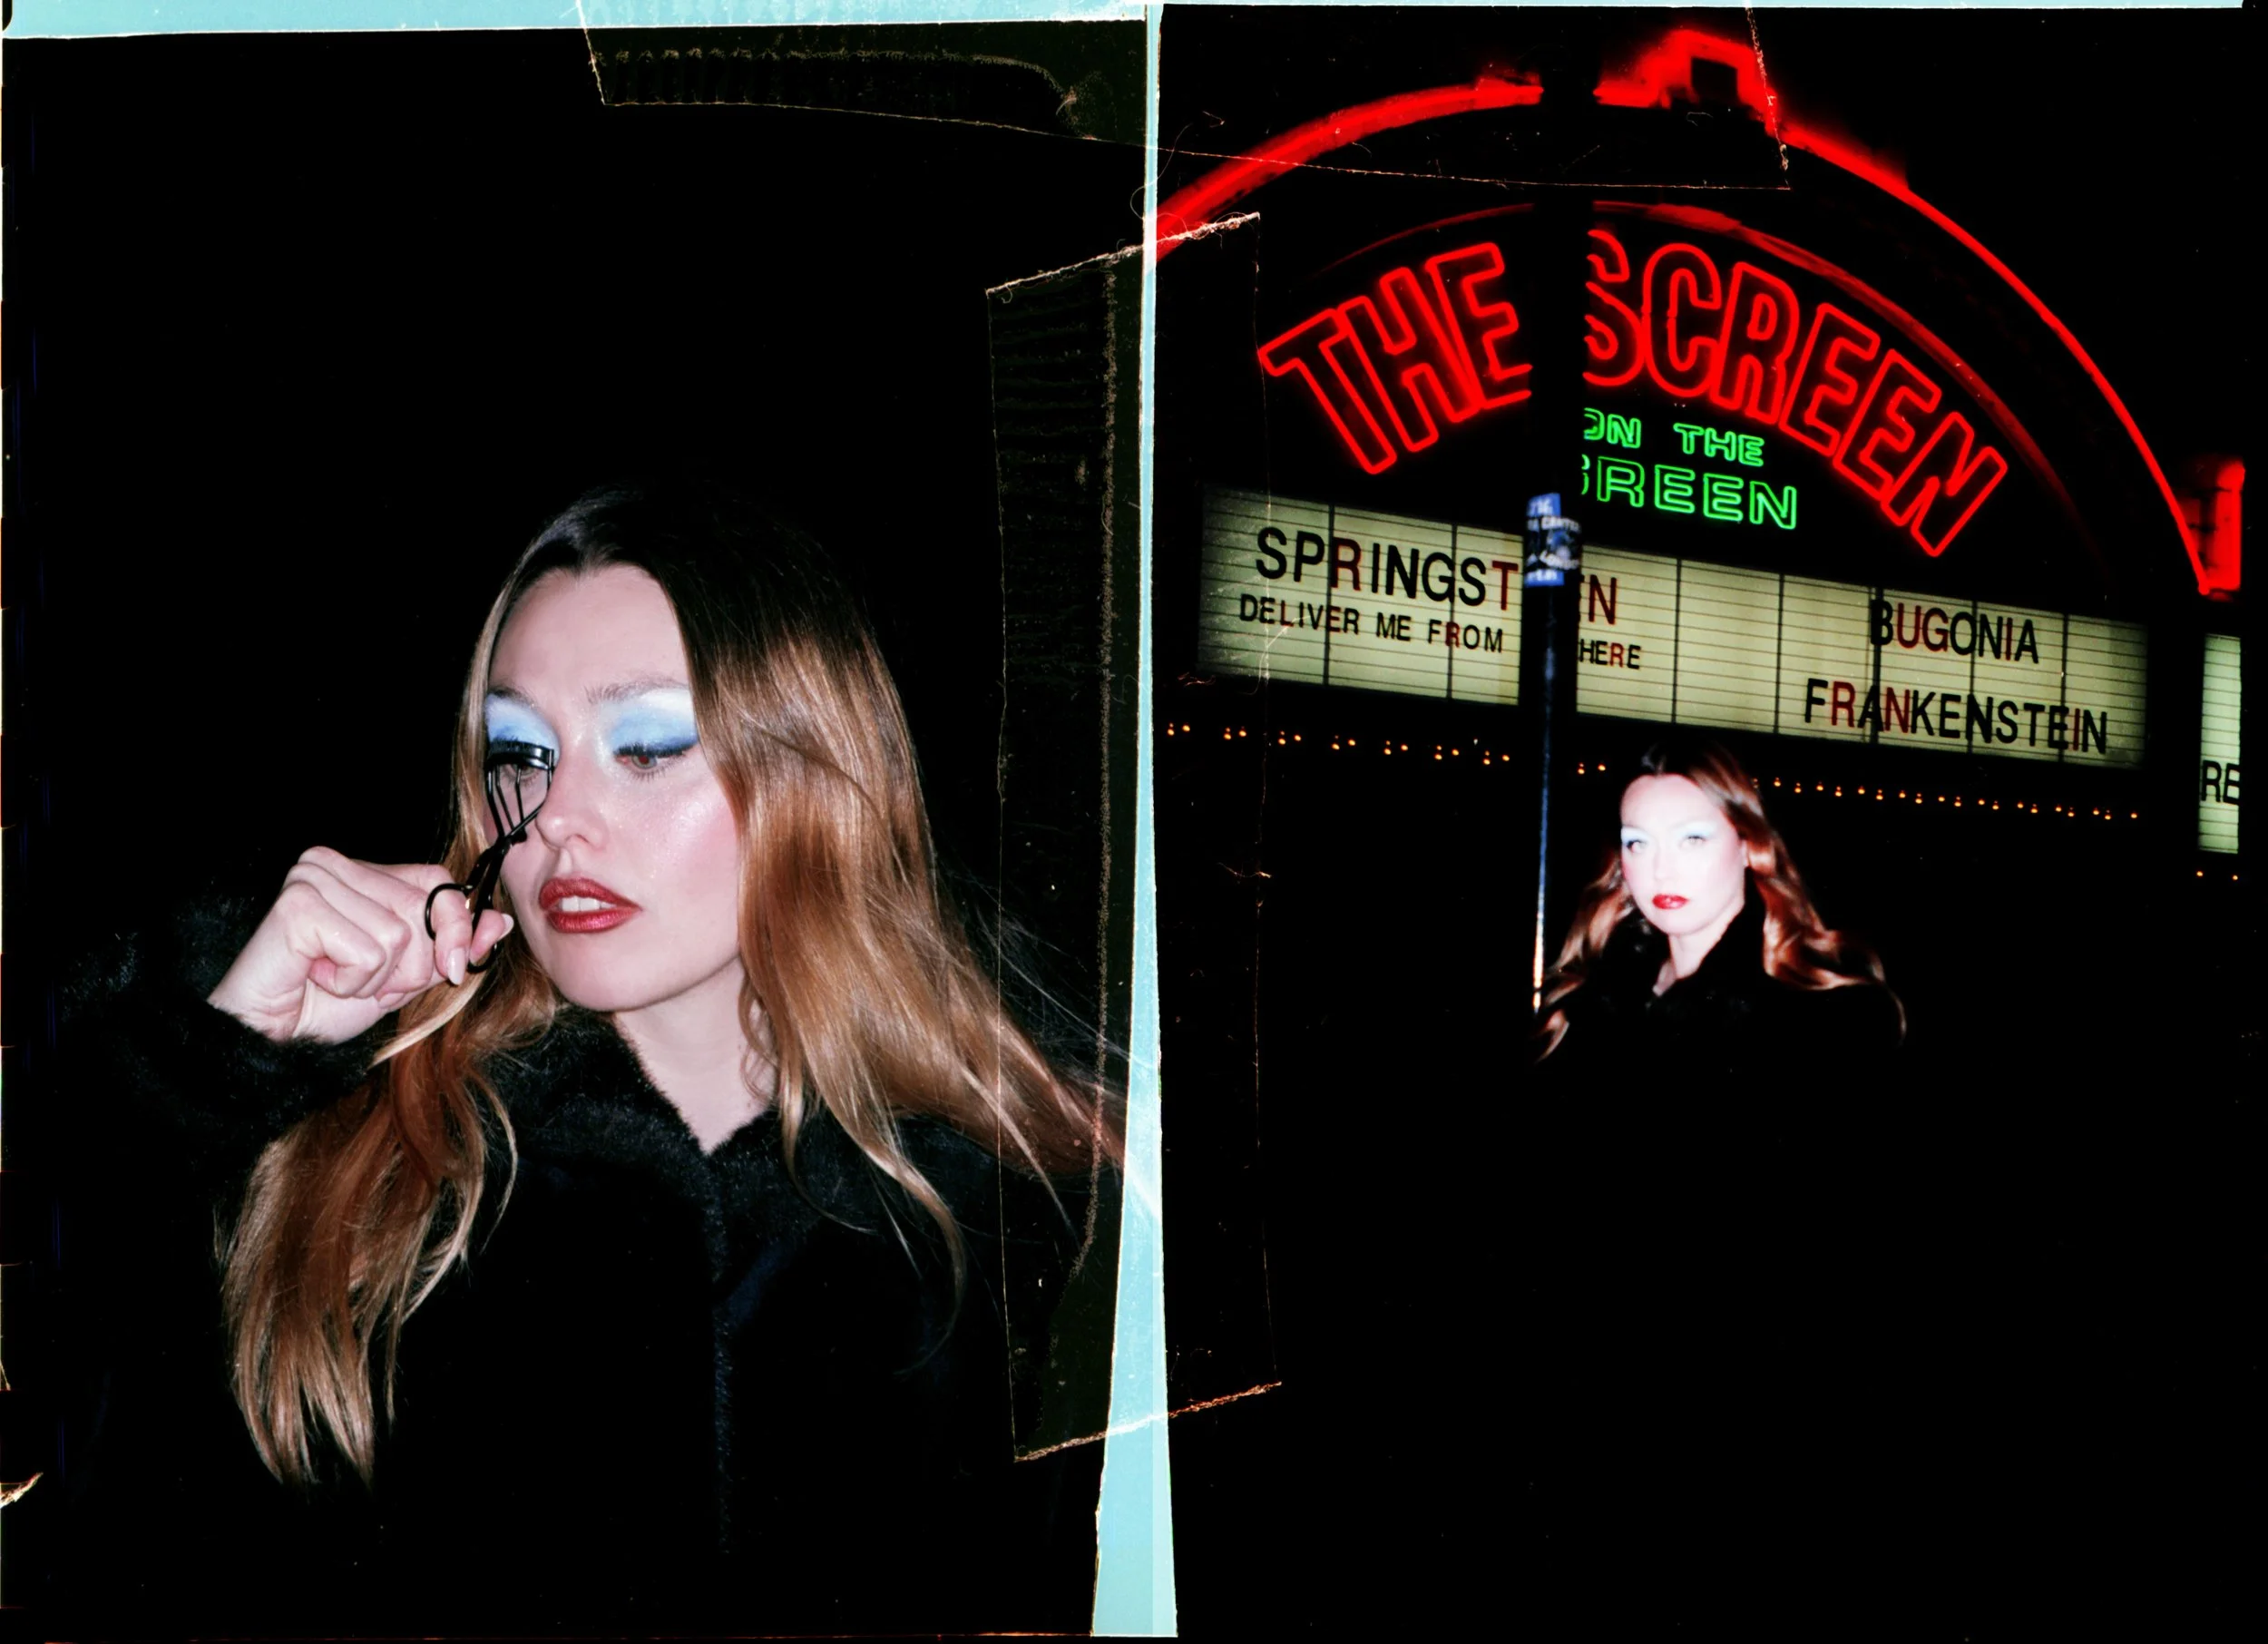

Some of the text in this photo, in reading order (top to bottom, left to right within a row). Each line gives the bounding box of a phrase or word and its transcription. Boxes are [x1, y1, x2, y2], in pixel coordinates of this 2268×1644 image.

[1258, 228, 2009, 557] THE SCREEN
[1672, 422, 1765, 467] THE
[1581, 453, 1797, 531] REEN
[1255, 526, 1618, 625] SPRINGSTN
[1238, 592, 1361, 636] DELIVER
[1375, 612, 1412, 641] ME
[1427, 619, 1503, 653] FROM
[1871, 599, 2040, 665] BUGONIA
[1804, 677, 2108, 755] FRANKENSTEIN
